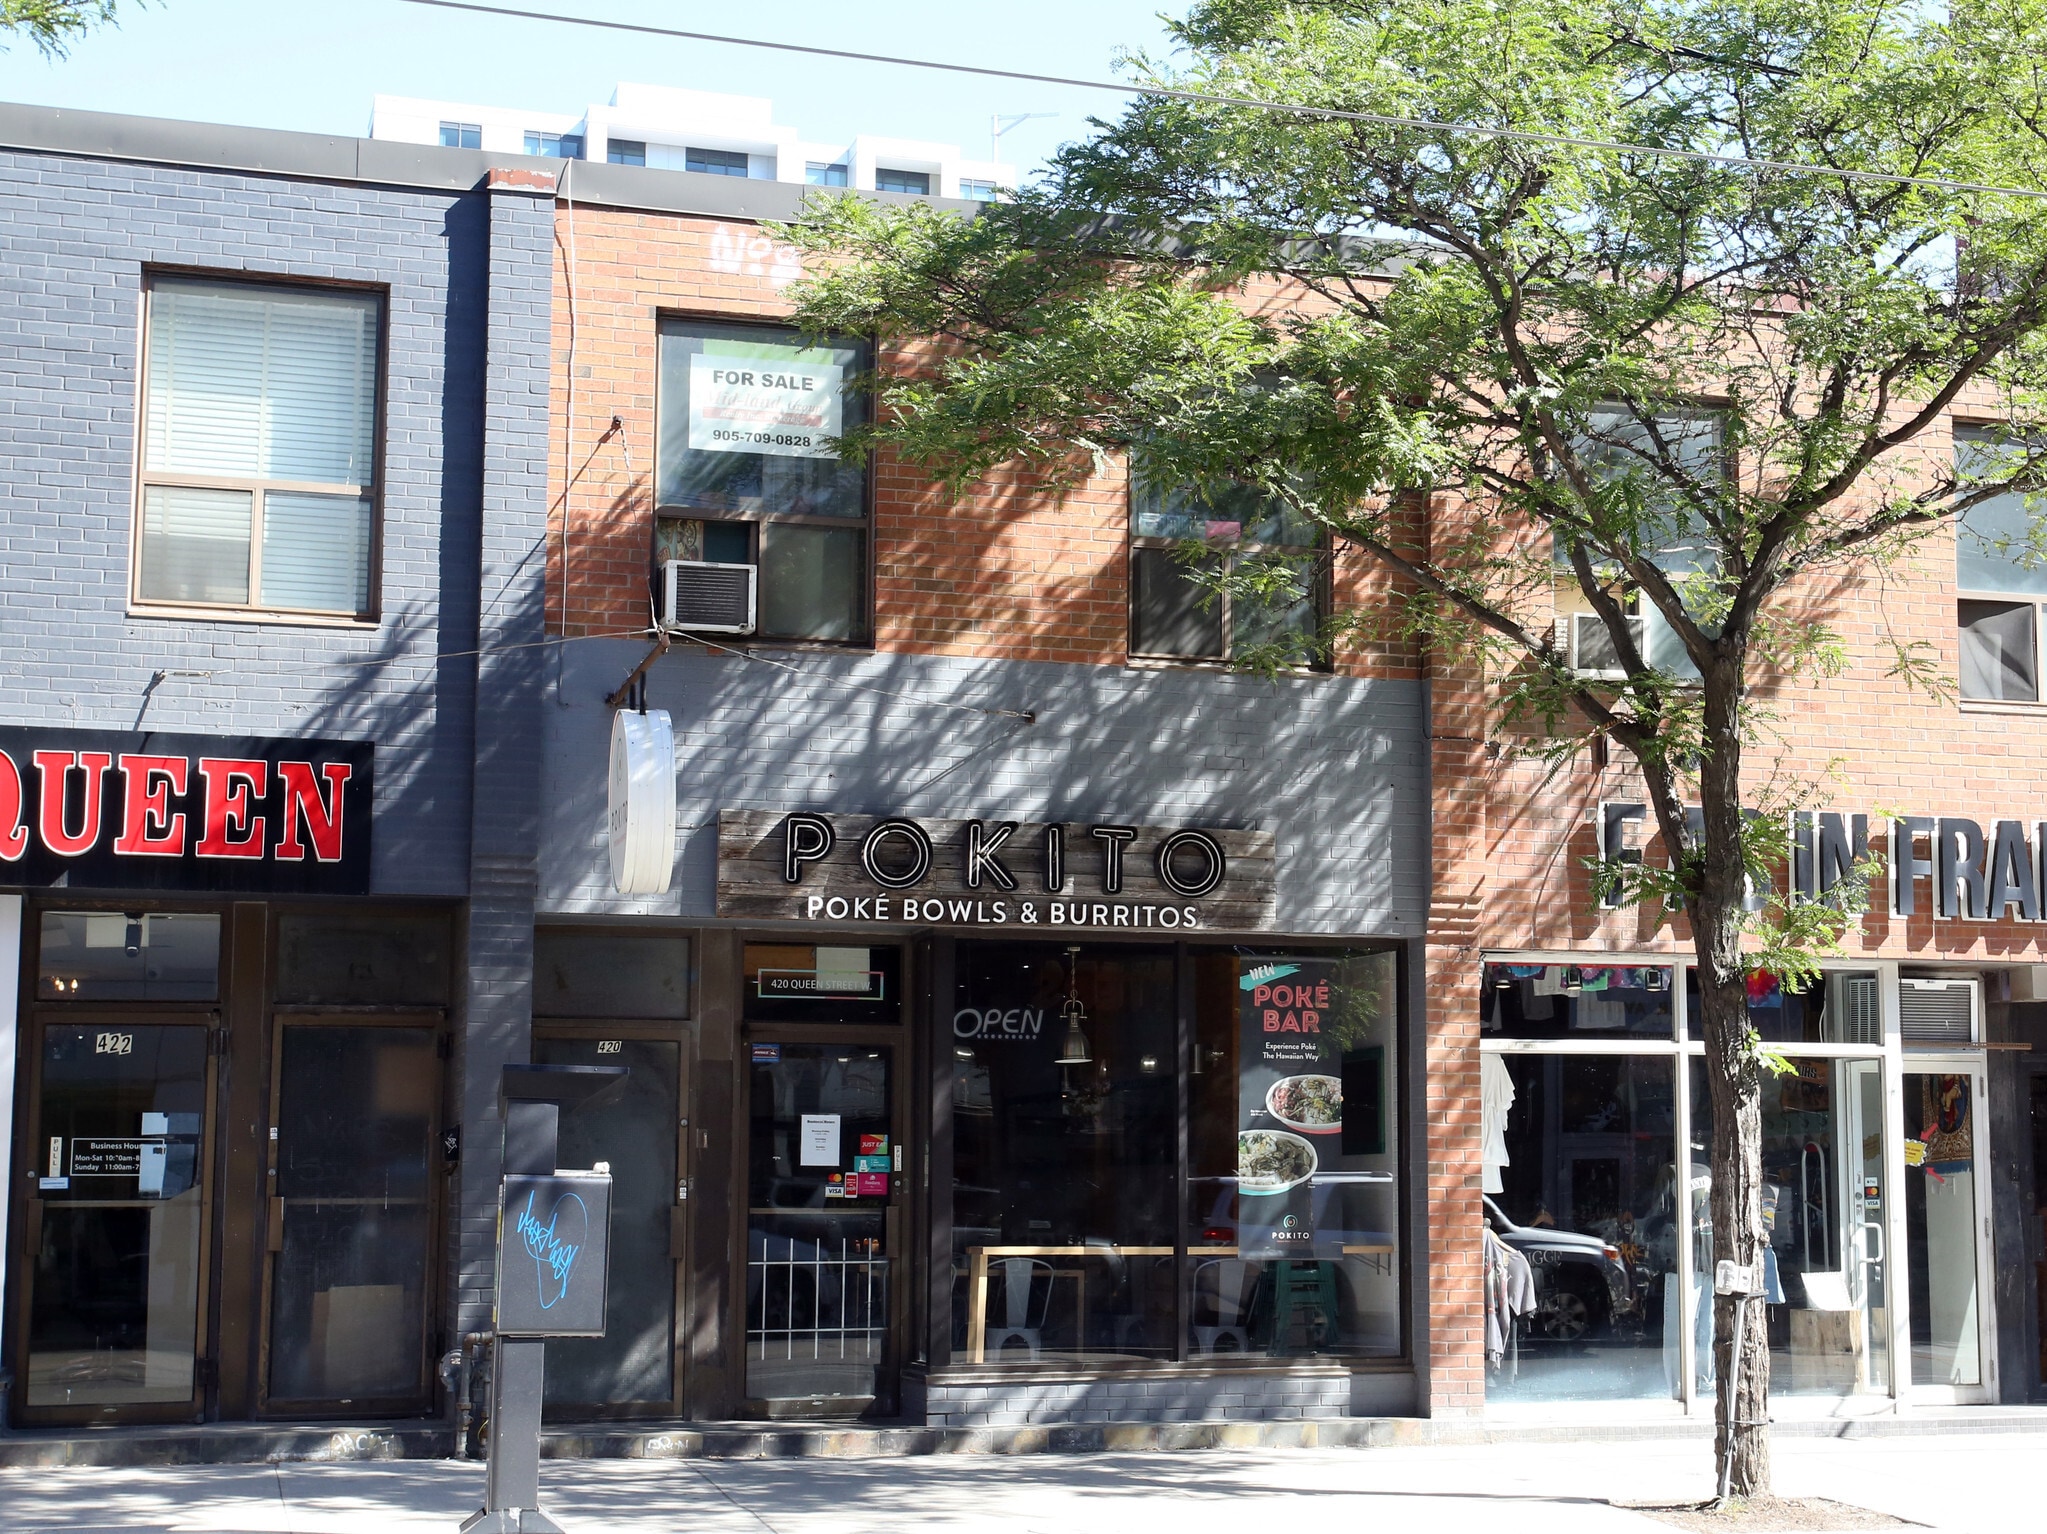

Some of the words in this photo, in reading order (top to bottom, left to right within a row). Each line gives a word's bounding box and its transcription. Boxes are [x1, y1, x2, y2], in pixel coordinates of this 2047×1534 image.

[713, 370, 754, 387] FOR
[762, 373, 813, 391] SALE
[713, 430, 811, 447] 905-709-0828
[784, 812, 1227, 897] POKITO
[1789, 810, 1869, 915] IN
[1888, 815, 2047, 922] FRA
[807, 893, 889, 921] POKÉ
[904, 898, 1006, 924] BOWLS
[1020, 902, 1039, 924] &
[1050, 902, 1198, 929] BURRITOS
[1249, 962, 1276, 981] NEW
[770, 979, 789, 989] 420
[791, 980, 823, 989] QUEEN
[826, 981, 859, 991] STREET
[861, 981, 873, 991] W.
[1253, 978, 1330, 1009] POKÉ
[954, 1008, 1044, 1038] OPEN
[1263, 1009, 1320, 1033] BAR
[98, 1034, 131, 1053] 422
[599, 1041, 621, 1053] 420
[1265, 1042, 1300, 1051] Experience
[1301, 1042, 1317, 1051] Poké
[1262, 1051, 1275, 1060] The
[1276, 1052, 1304, 1060] Hawaiian
[1305, 1053, 1319, 1062] Way
[90, 1142, 122, 1150] Business
[1271, 1231, 1310, 1240] POKITO
